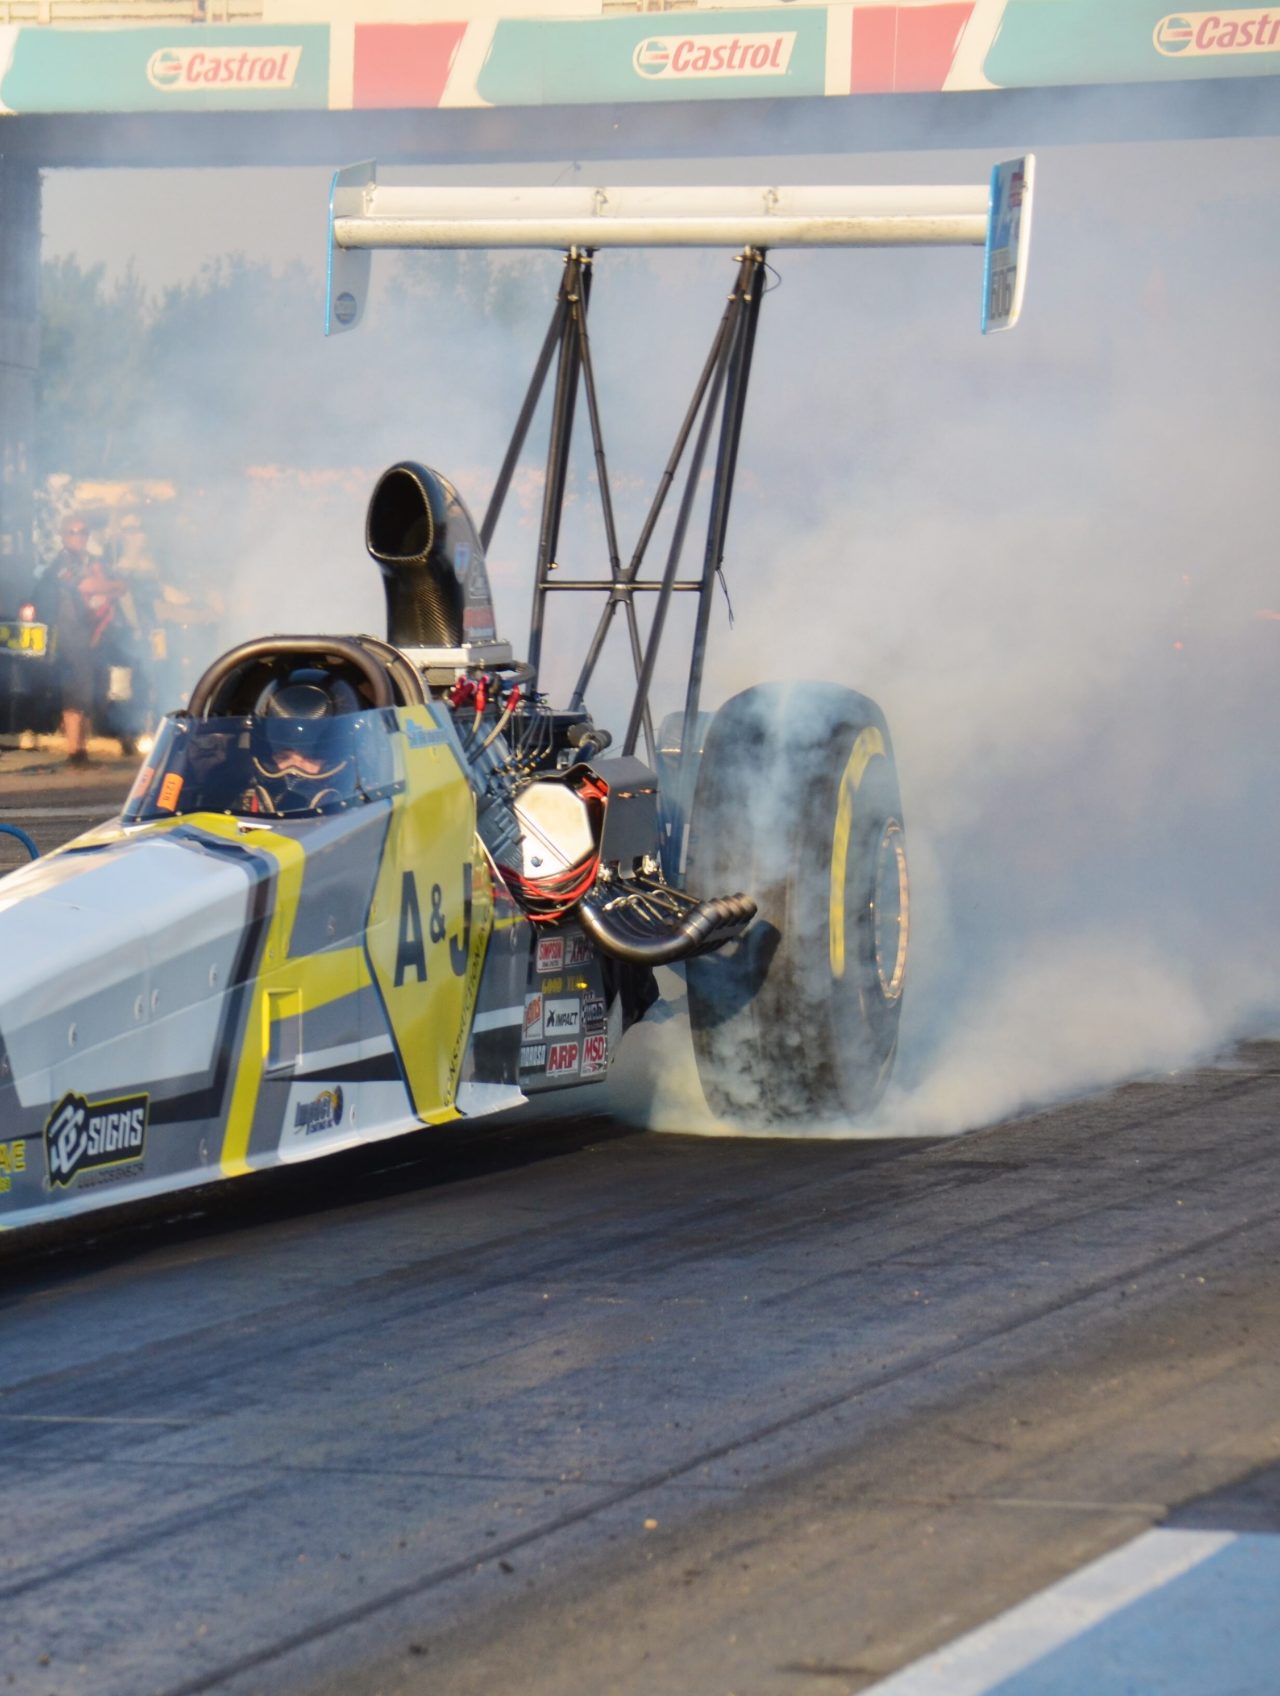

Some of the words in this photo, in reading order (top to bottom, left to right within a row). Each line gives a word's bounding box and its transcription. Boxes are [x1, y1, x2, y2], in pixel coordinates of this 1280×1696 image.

[186, 52, 290, 83] Castrol
[671, 38, 784, 73] Castrol
[393, 870, 428, 987] A
[429, 883, 446, 944] &
[555, 1011, 578, 1028] IMPACT
[548, 1044, 578, 1071] ARP
[585, 1036, 605, 1062] MSD
[87, 1107, 145, 1156] SIGNS
